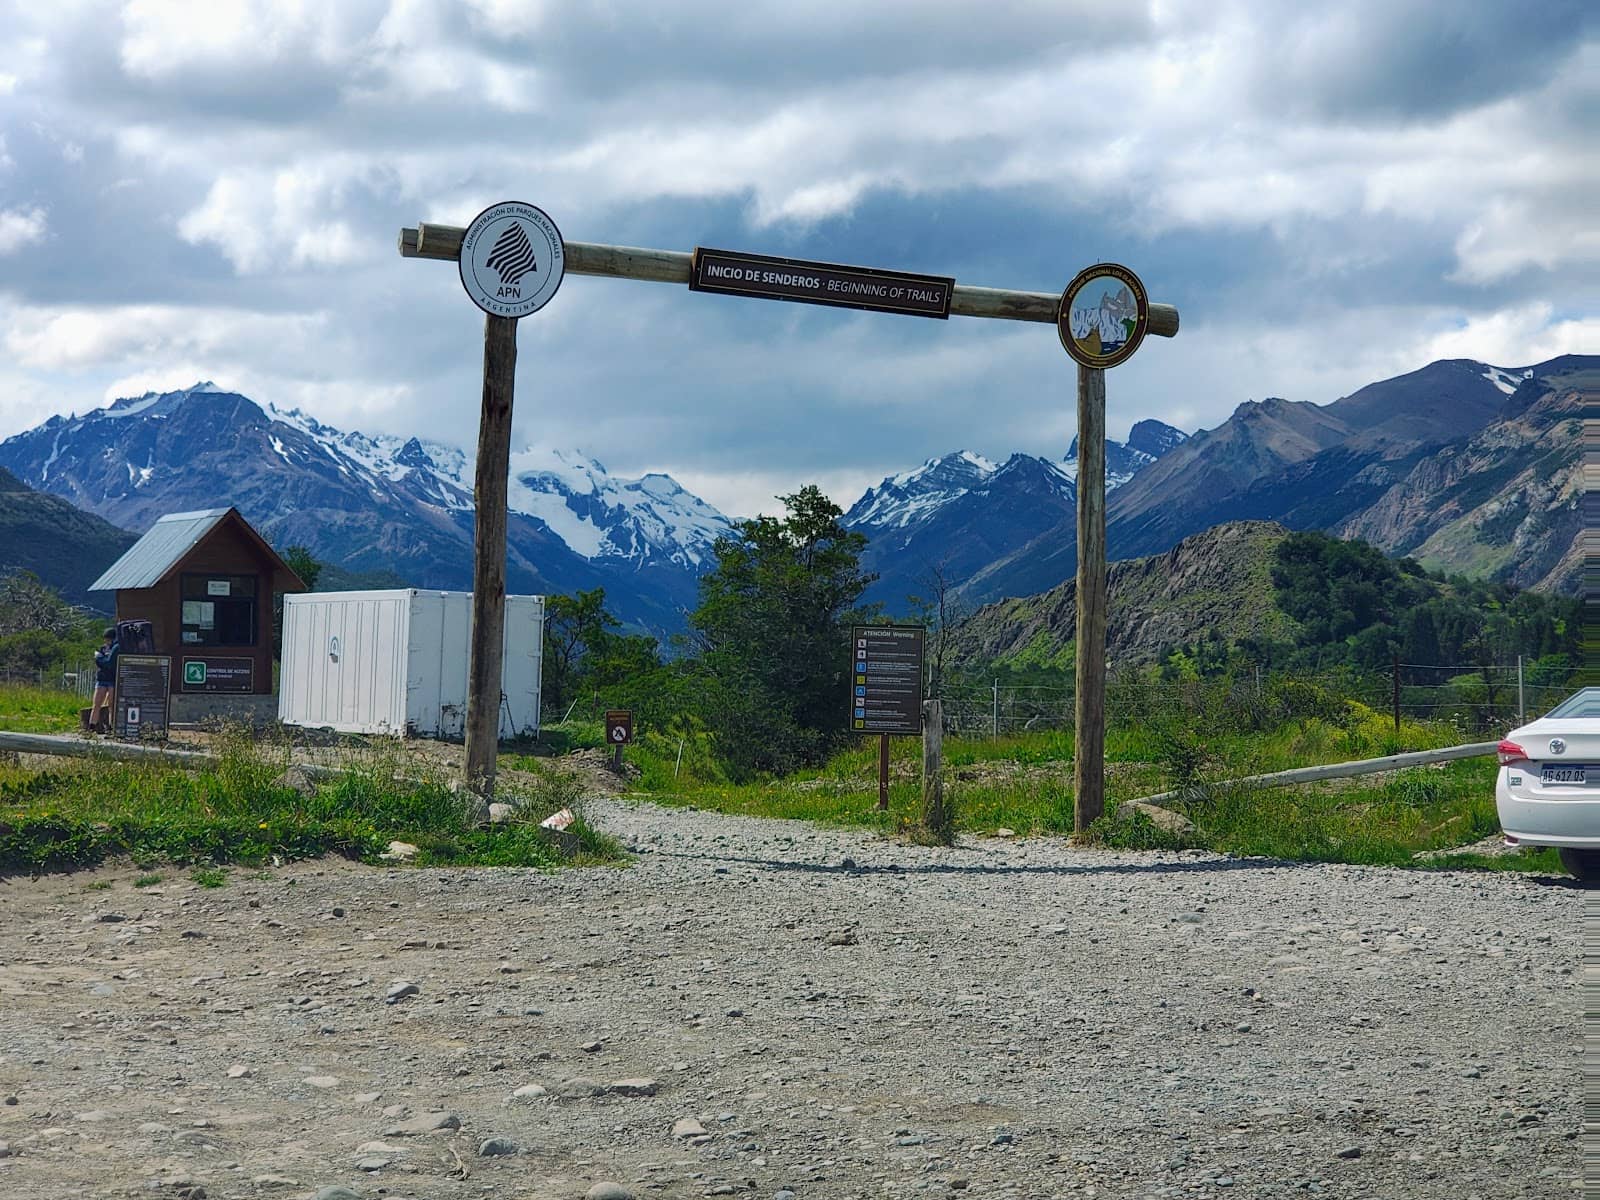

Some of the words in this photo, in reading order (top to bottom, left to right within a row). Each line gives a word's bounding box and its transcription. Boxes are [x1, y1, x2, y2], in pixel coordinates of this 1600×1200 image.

[466, 207, 506, 251] ADMINISTRACIÓN
[516, 208, 542, 222] PARQUES
[541, 221, 560, 259] NACIONALES
[496, 286, 521, 299] APN
[707, 265, 743, 280] INICIO
[745, 269, 761, 282] DE
[762, 272, 820, 288] SENDEROS
[827, 279, 887, 297] BEGINNING
[889, 287, 904, 299] OF
[906, 288, 941, 303] TRAILS
[480, 298, 537, 313] ARGENTINA
